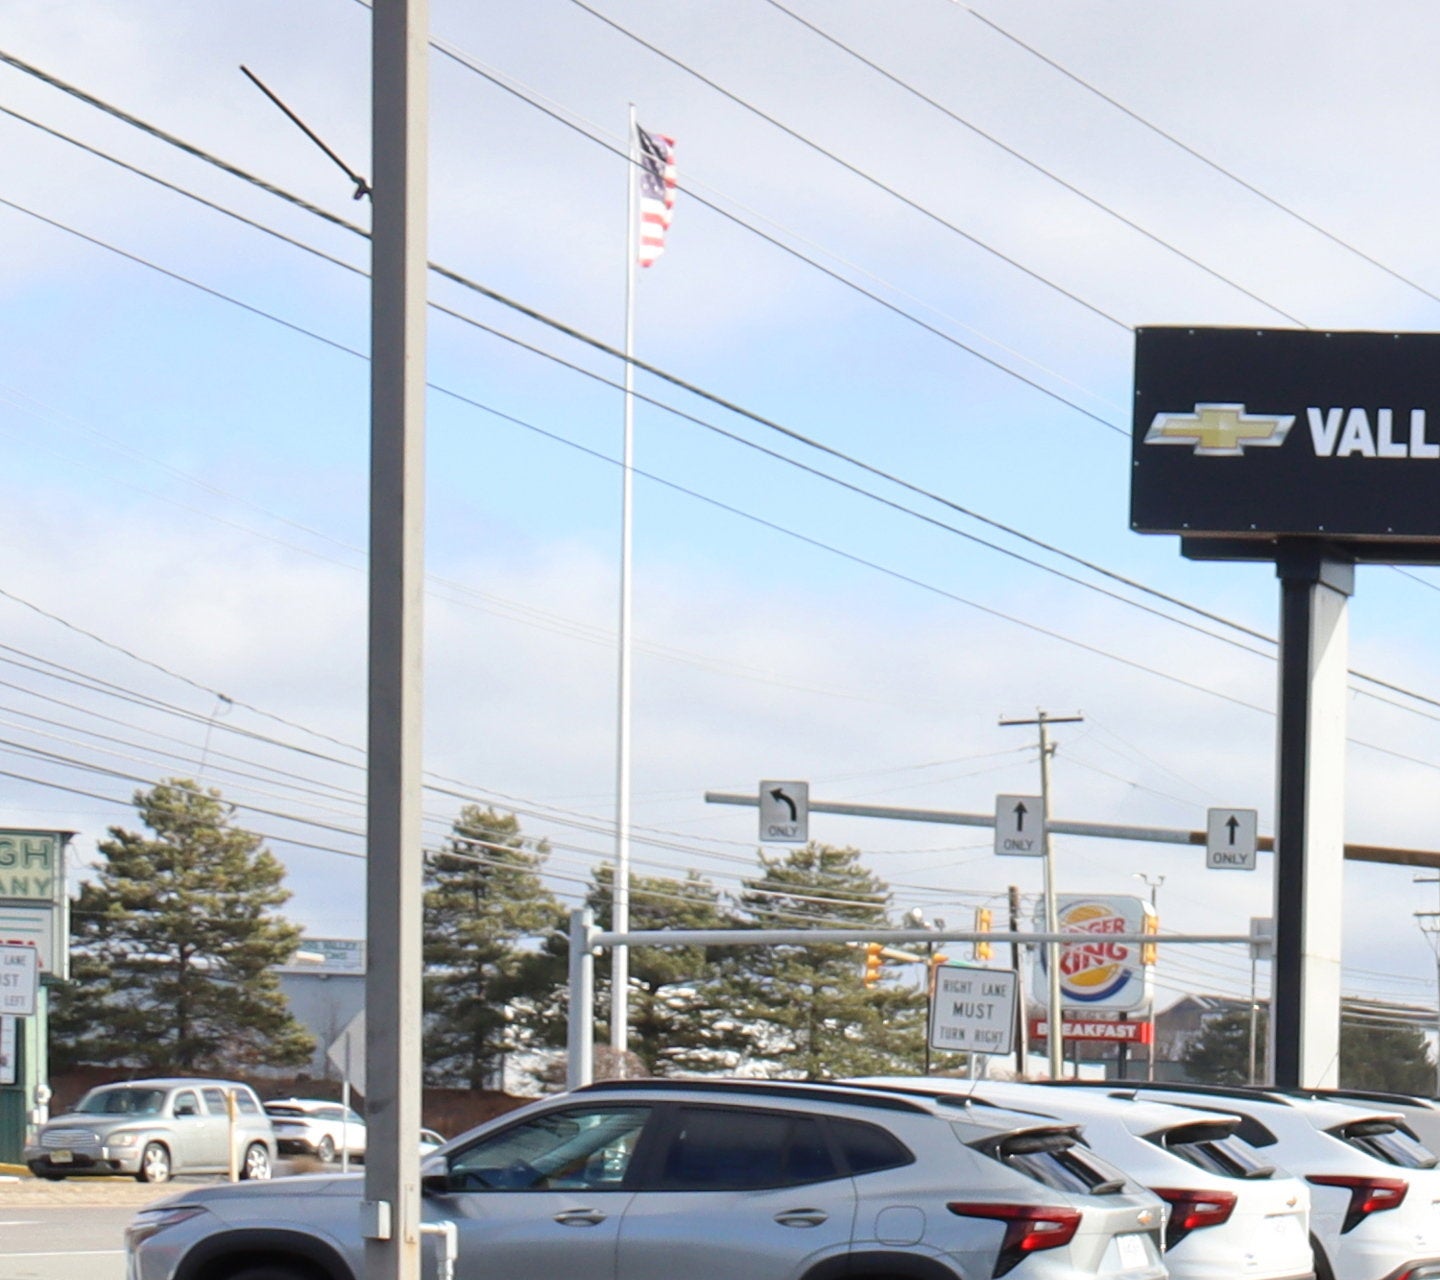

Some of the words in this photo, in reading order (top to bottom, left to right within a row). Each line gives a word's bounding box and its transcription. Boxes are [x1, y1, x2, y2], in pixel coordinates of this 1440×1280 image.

[767, 824, 798, 838] ONLY
[1003, 838, 1034, 851] ONLY
[1213, 852, 1248, 865] ONLY
[943, 979, 973, 994] RIGHT
[981, 982, 1007, 998] LANE
[953, 1002, 995, 1020] MUST
[940, 1026, 966, 1041] TURN
[975, 1029, 1004, 1044] RIGHT
[1037, 1022, 1137, 1038] BEAKFAST
